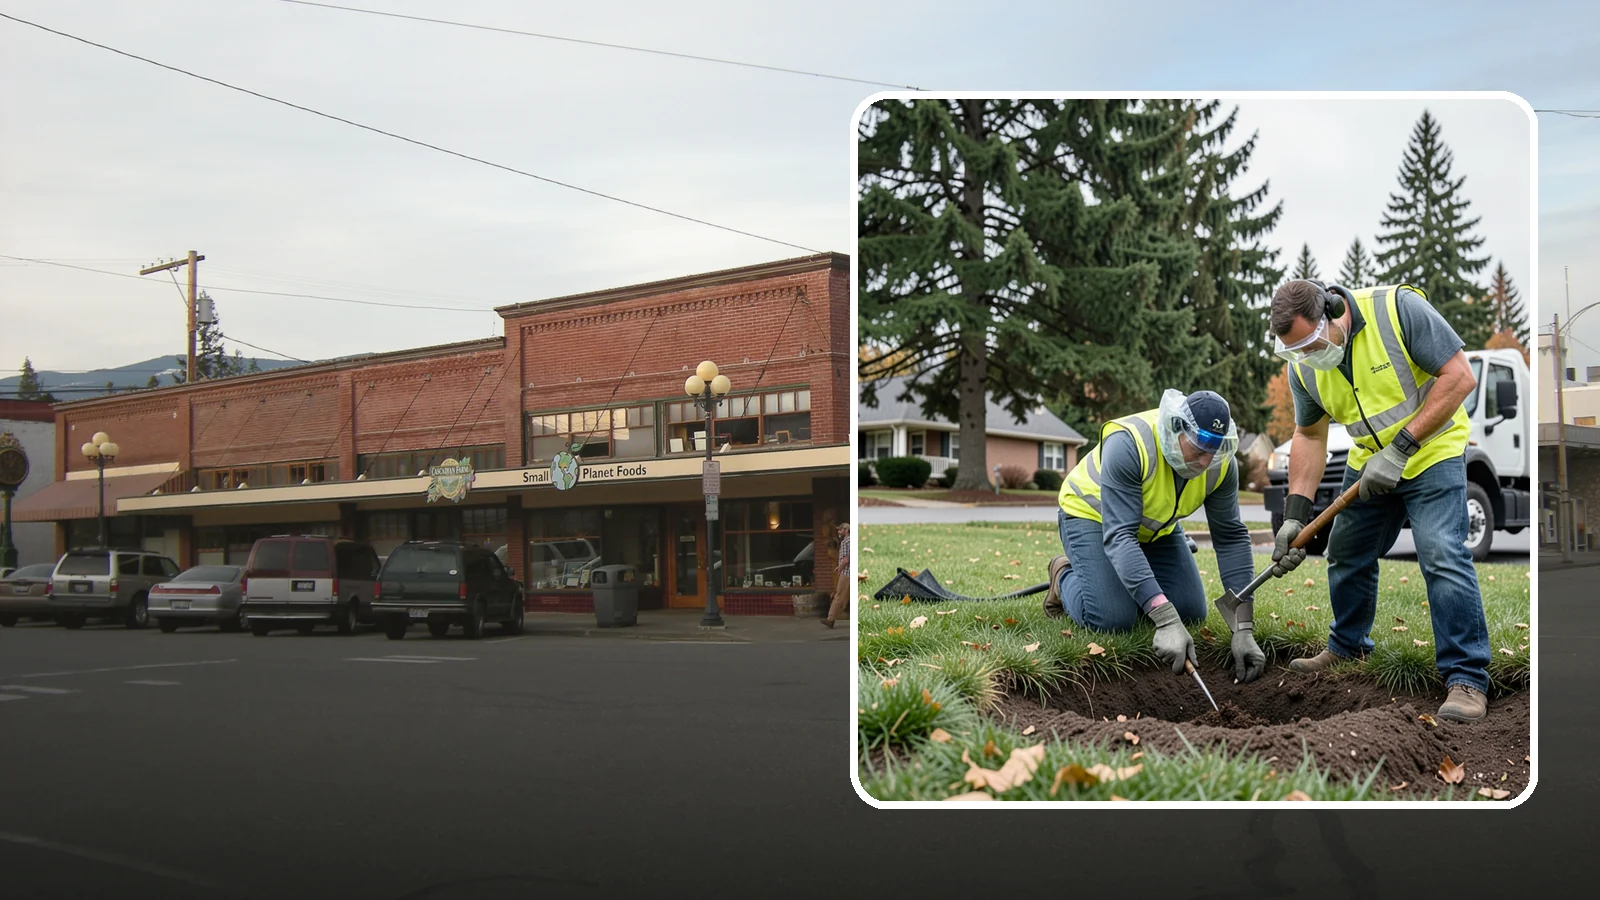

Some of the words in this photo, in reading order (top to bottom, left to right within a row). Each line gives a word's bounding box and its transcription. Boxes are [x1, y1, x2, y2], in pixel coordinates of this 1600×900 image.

[523, 471, 549, 483] Small
[583, 467, 614, 479] Planet
[617, 464, 647, 477] Foods
